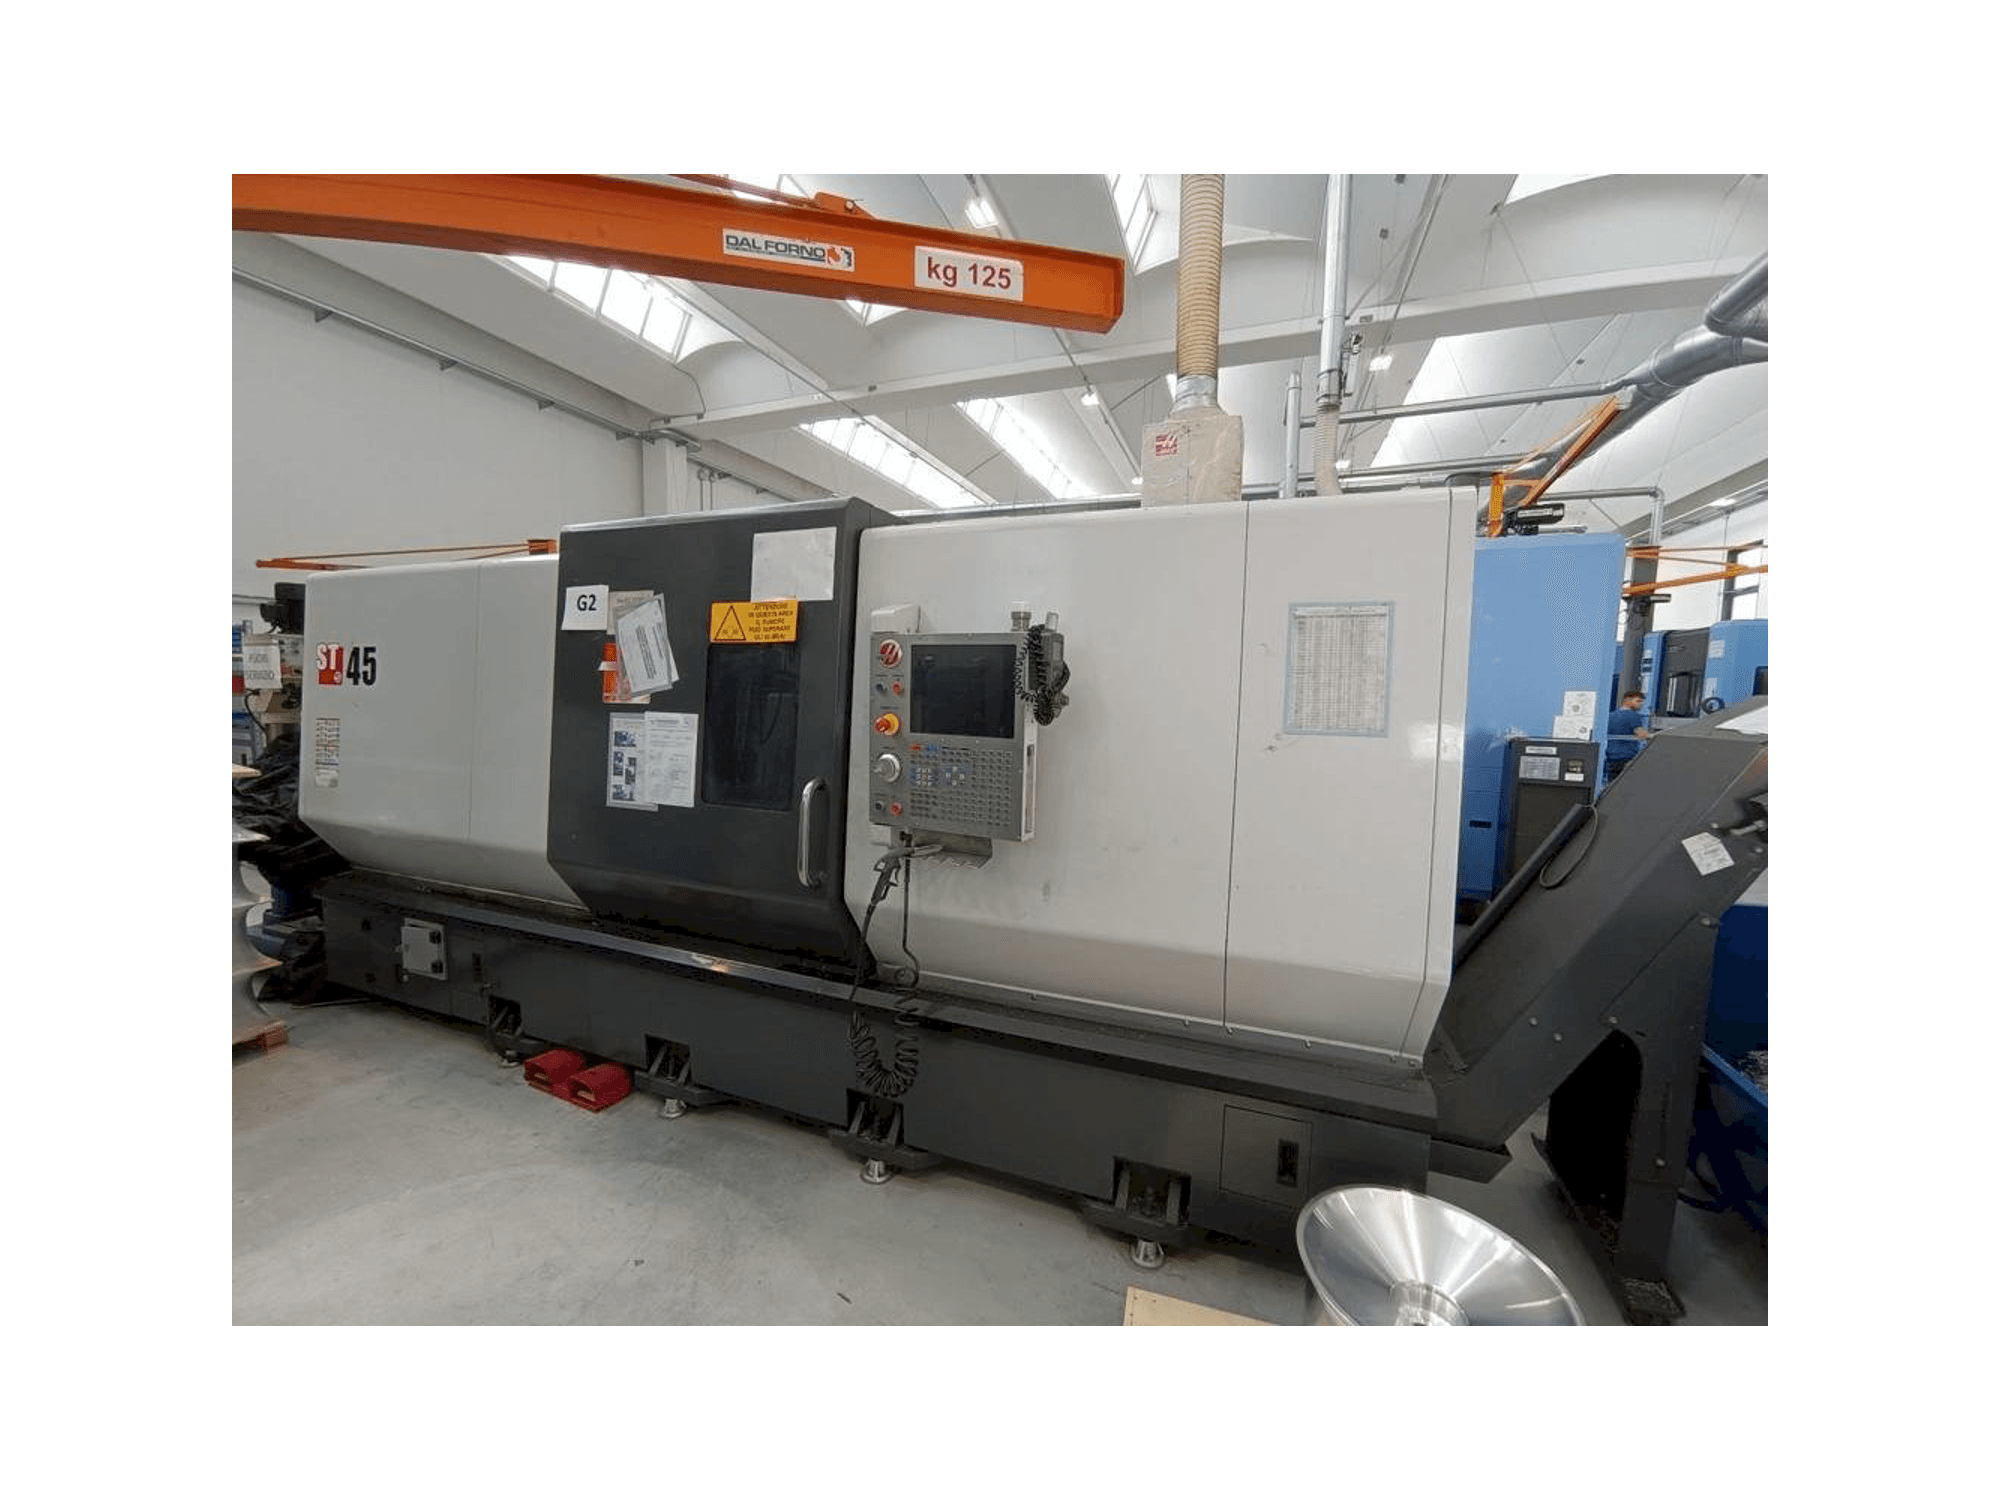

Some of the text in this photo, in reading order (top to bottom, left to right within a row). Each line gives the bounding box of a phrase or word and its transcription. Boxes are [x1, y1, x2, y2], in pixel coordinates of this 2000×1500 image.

[726, 234, 826, 259] DAL FORNO
[927, 256, 1012, 290] kg 125
[576, 593, 598, 612] G2
[316, 643, 377, 686] ST 45
